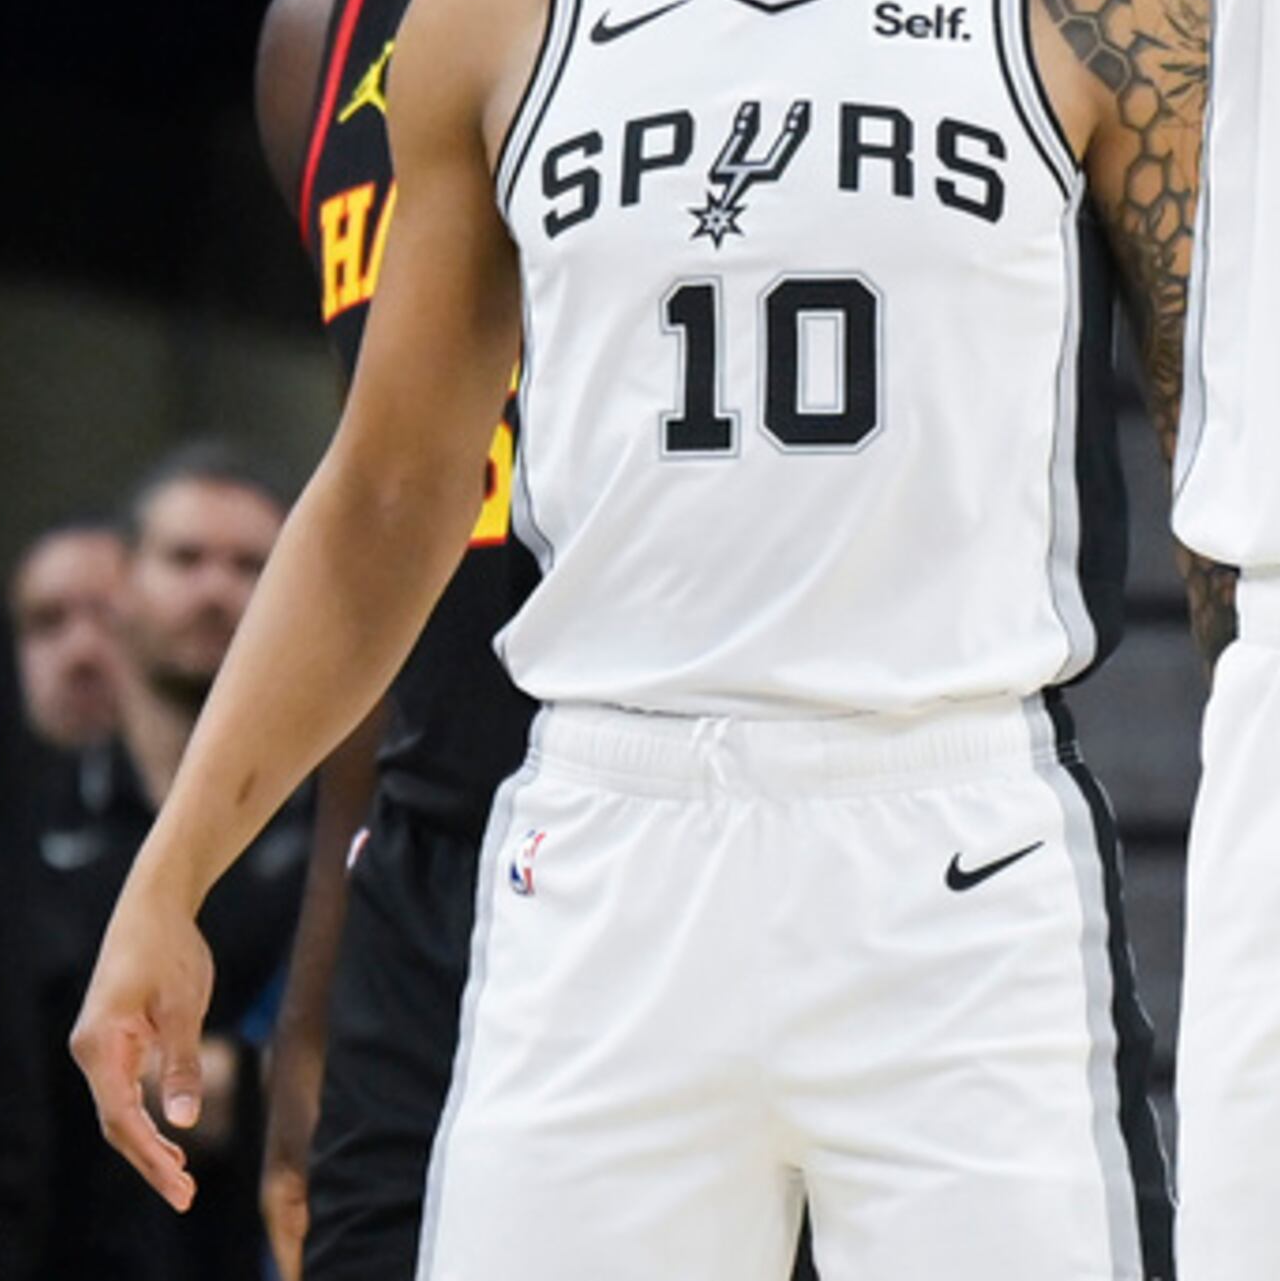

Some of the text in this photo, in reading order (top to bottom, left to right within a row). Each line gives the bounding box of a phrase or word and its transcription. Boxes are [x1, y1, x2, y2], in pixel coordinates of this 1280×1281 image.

[873, 1, 971, 41] Self.
[541, 100, 1008, 250] SPURS
[658, 270, 884, 461] 10
